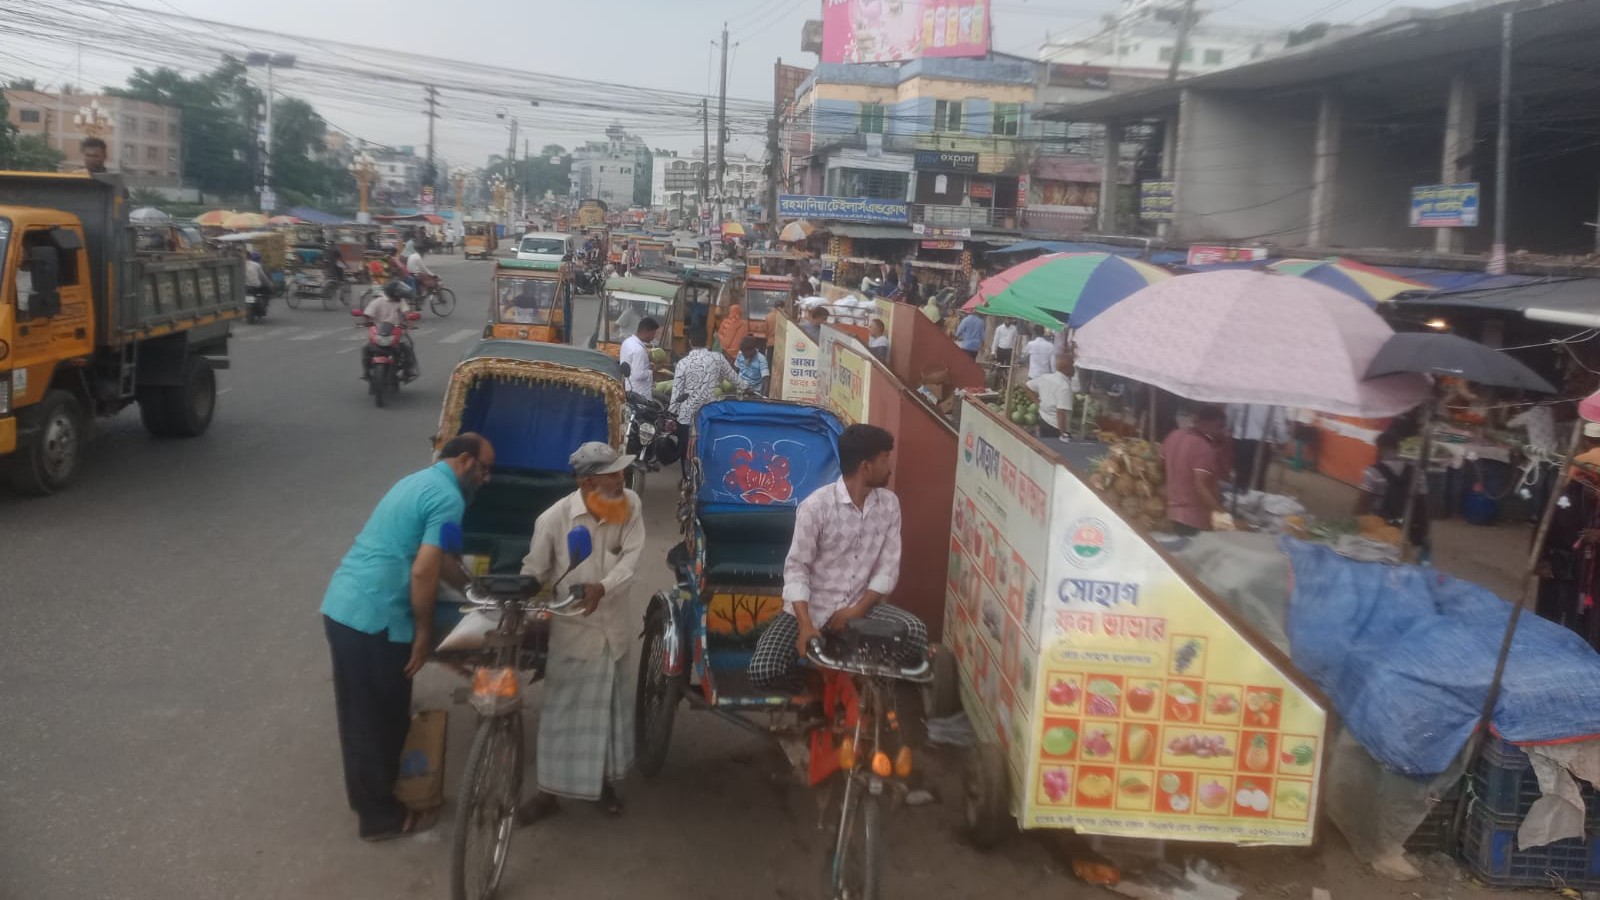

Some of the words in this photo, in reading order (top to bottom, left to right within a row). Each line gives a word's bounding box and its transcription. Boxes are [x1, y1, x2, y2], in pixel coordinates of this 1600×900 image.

[975, 436, 1000, 480] সোহাগ
[1058, 578, 1139, 608] সোহাগ
[1055, 610, 1096, 636] ফল
